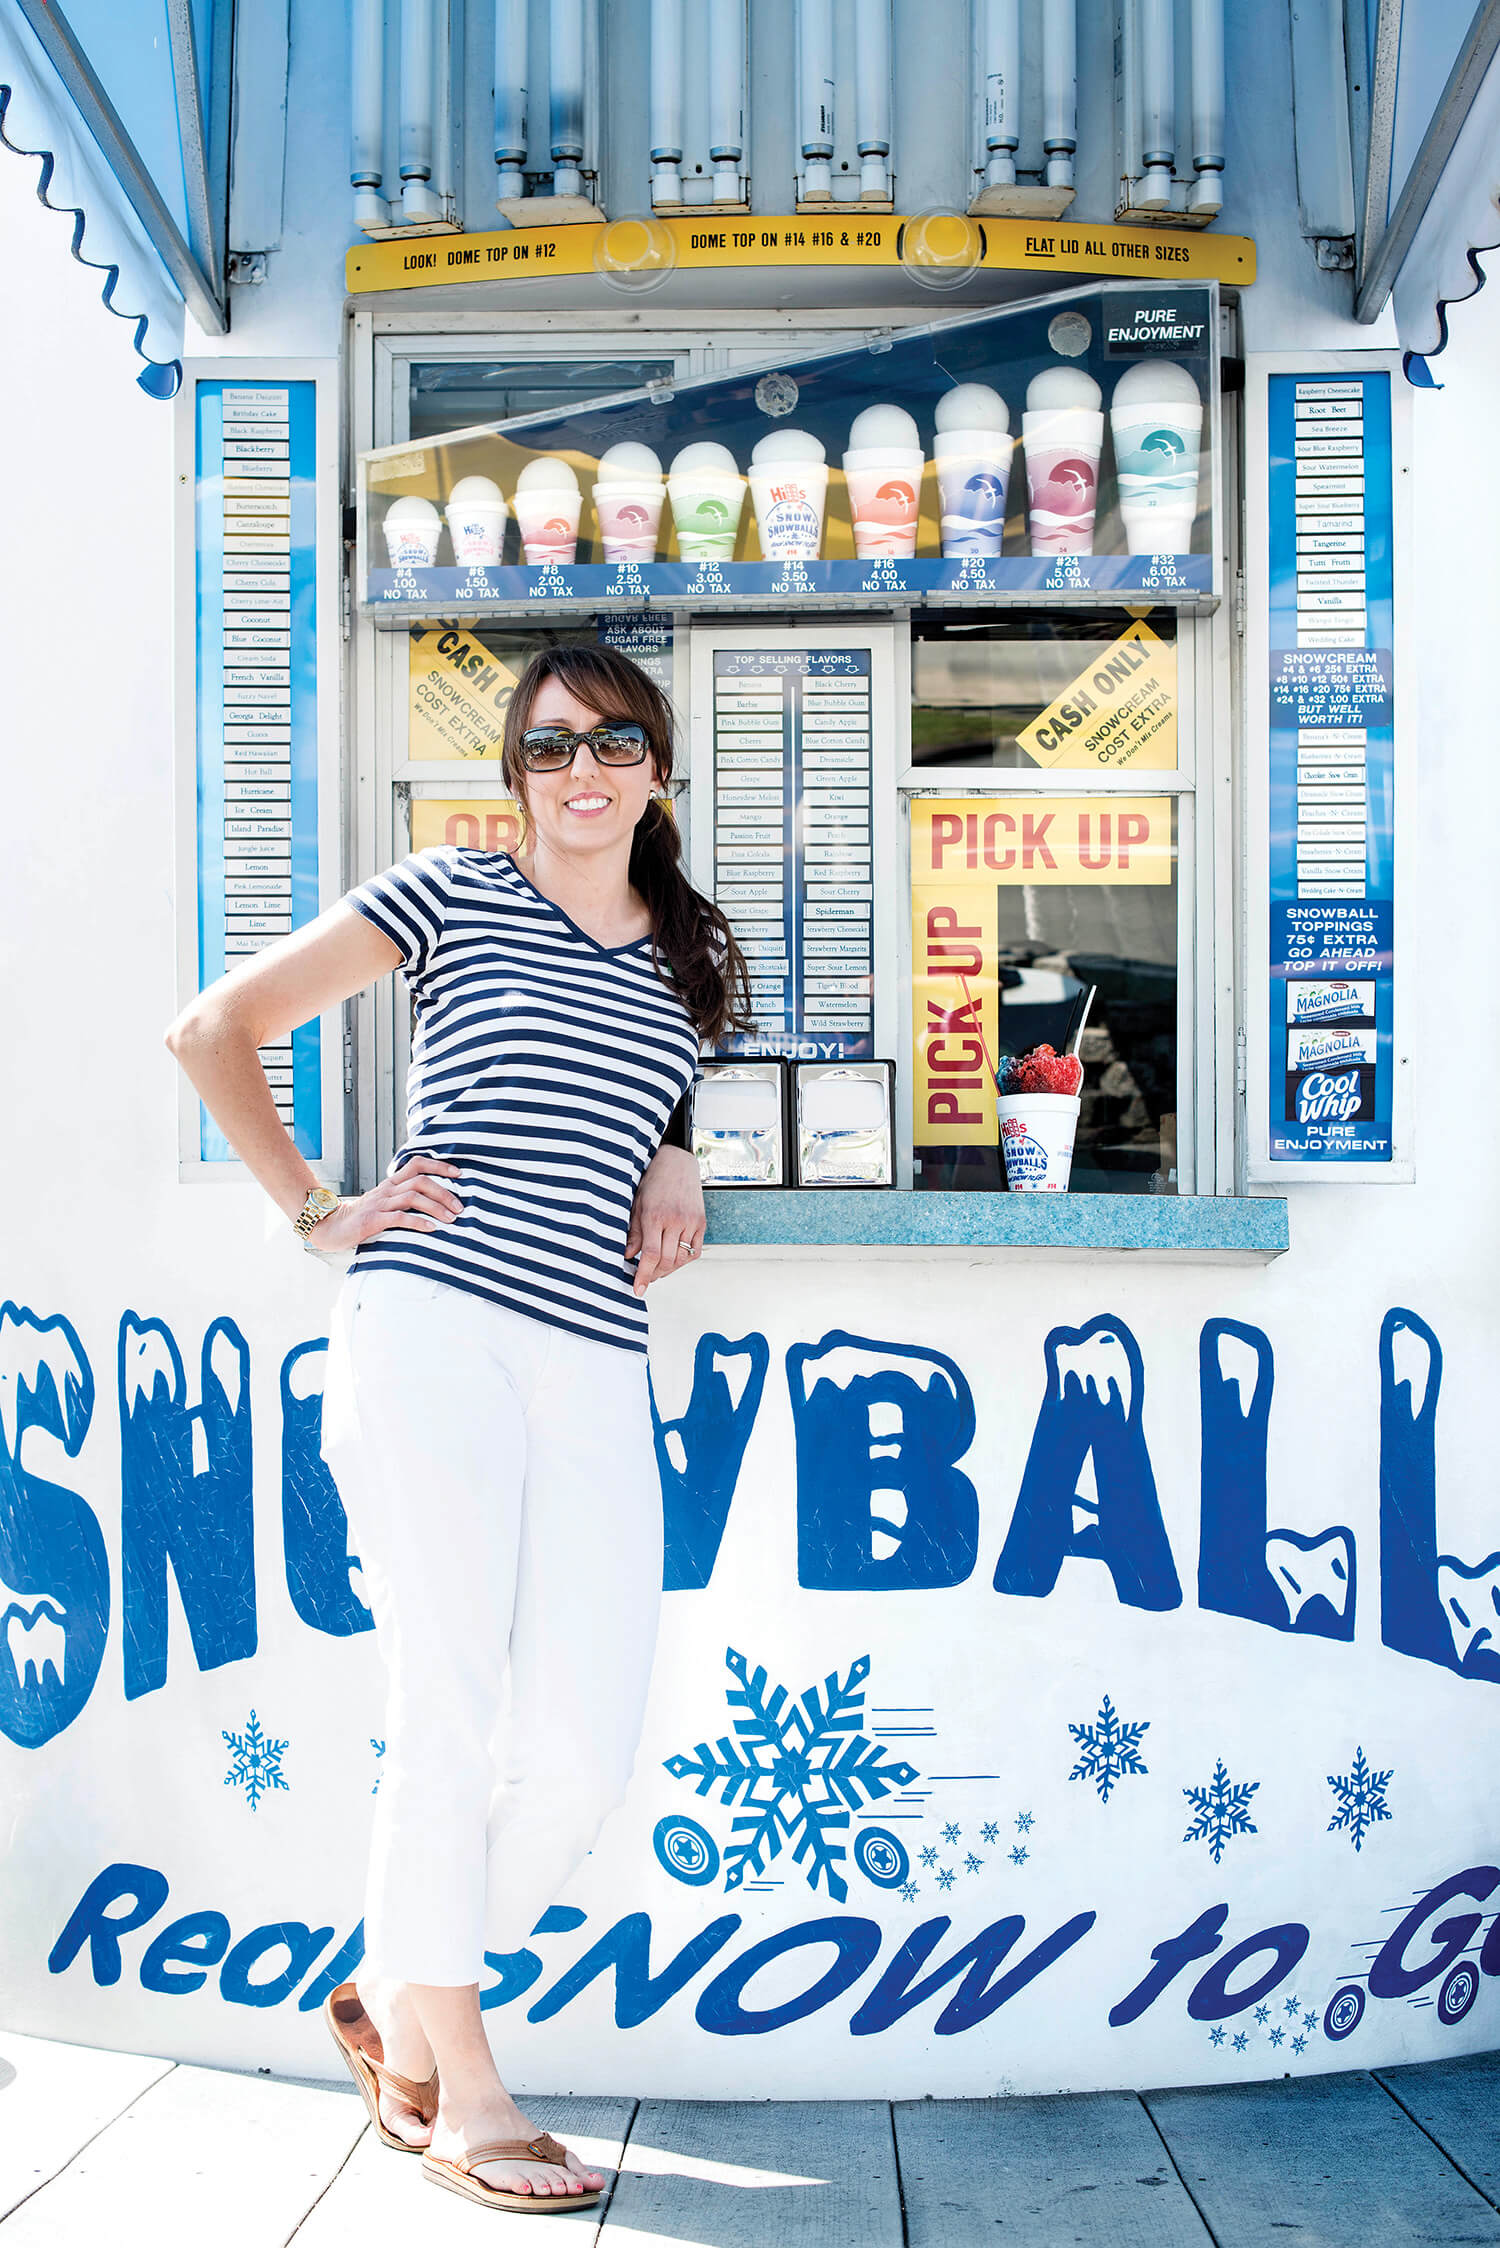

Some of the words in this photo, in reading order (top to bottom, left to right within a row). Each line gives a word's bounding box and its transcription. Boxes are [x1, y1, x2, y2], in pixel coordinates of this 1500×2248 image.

[691, 234, 726, 249] DOME
[732, 233, 756, 247] TOP
[761, 232, 778, 246] ON
[784, 232, 806, 246] #14
[812, 232, 834, 247] #16
[841, 232, 849, 246] &
[857, 232, 881, 247] #20
[1026, 237, 1055, 253] FLAT
[1061, 239, 1079, 254] LID
[1085, 240, 1107, 256] ALL
[1111, 242, 1149, 259] OTHER
[1155, 246, 1190, 262] SIZES
[404, 253, 437, 270] LOOK!
[448, 250, 480, 266] DOME
[486, 247, 508, 262] TOP
[514, 245, 529, 259] ON
[535, 243, 556, 258] #12
[1134, 309, 1176, 323] PURE
[1108, 325, 1204, 341] ENJOYMENT
[776, 513, 813, 522] SNOW
[768, 523, 818, 538] SNOWBALLS
[1313, 540, 1346, 548] Tangerine
[873, 559, 894, 569] #16
[961, 558, 985, 568] #20
[1056, 556, 1079, 566] #24
[1152, 555, 1174, 565] #32
[543, 565, 558, 575] #8
[618, 564, 639, 573] #10
[699, 562, 719, 572] #12
[784, 561, 804, 570] #14
[397, 567, 412, 578] #4
[469, 566, 484, 576] #6
[871, 570, 897, 580] 4.00
[960, 569, 985, 579] 4.50
[1054, 567, 1080, 577] 5.00
[1150, 566, 1176, 576] 6.00
[538, 576, 564, 586] 2.00
[616, 574, 641, 584] 2.50
[696, 573, 722, 583] 3.00
[782, 572, 808, 582] 3.50
[1142, 577, 1160, 587] NO
[1164, 576, 1186, 586] TAX
[393, 578, 416, 588] 1.00
[465, 578, 488, 587] 1.50
[772, 583, 789, 592] NO
[794, 582, 816, 592] TAX
[862, 581, 880, 591] NO
[885, 581, 906, 590] TAX
[952, 580, 969, 590] NO
[974, 579, 996, 589] TAX
[1046, 578, 1063, 588] NO
[1069, 578, 1090, 588] TAX
[384, 589, 402, 599] NO
[407, 589, 427, 599] TAX
[456, 589, 473, 598] NO
[479, 588, 499, 597] TAX
[529, 587, 547, 597] NO
[552, 586, 573, 596] TAX
[606, 585, 623, 595] NO
[628, 585, 650, 595] TAX
[687, 584, 704, 594] NO
[710, 584, 731, 593] TAX
[437, 632, 499, 693] CASH
[1284, 654, 1377, 664] SNOWCREAM
[1283, 665, 1294, 673] #4
[1298, 665, 1305, 673] &
[1310, 665, 1320, 673] #6
[1346, 665, 1377, 673] EXTRA
[231, 673, 254, 681] French
[260, 673, 284, 681] Vanilla
[1312, 675, 1326, 683] #12
[1352, 675, 1384, 683] EXTRA
[1036, 689, 1098, 750] CASH
[1093, 634, 1151, 695] ONLY
[1274, 685, 1289, 693] #14
[1294, 685, 1309, 693] #16
[1313, 685, 1330, 693] #20
[1309, 695, 1325, 703] #32
[1330, 695, 1348, 703] 1.00
[1352, 695, 1384, 703] EXTRA
[428, 671, 501, 743] SNOWCREAM
[1298, 705, 1323, 713] BUT
[1328, 705, 1361, 713] WELL
[1085, 678, 1159, 751] SNOWCREAM
[1299, 715, 1342, 723] WORTH
[1346, 715, 1362, 723] IT!
[417, 684, 449, 715] COST
[448, 716, 486, 756] EXTRA
[1098, 729, 1130, 763] COST
[1131, 692, 1172, 731] EXTRA
[1117, 756, 1126, 765] We
[1126, 741, 1142, 758] Don't
[1141, 732, 1152, 743] Mix
[1152, 712, 1173, 732] Creams
[931, 814, 1058, 869] PICK
[1078, 814, 1150, 869] UP
[1287, 908, 1378, 918] SNOWBALL
[249, 920, 266, 928] Lime
[1292, 922, 1373, 931] TOPPINGS
[928, 906, 983, 977] UP
[1286, 935, 1315, 944] 75¢
[1324, 935, 1378, 944] EXTRA
[1288, 948, 1312, 957] GO
[1320, 948, 1375, 957] AHEAD
[1283, 961, 1315, 971] TOP
[1322, 961, 1338, 971] IT
[1345, 961, 1382, 971] OFF!
[1297, 989, 1358, 1012] MAGNOLIA
[743, 1043, 844, 1059] ENJOY!
[1299, 1036, 1359, 1060] MAGNOLIA
[928, 997, 983, 1124] PICK
[1302, 1071, 1359, 1100] Cool
[1300, 1091, 1361, 1124] Whip
[1307, 1126, 1355, 1136] PURE
[1275, 1140, 1387, 1150] ENJOYMENT
[1006, 1147, 1035, 1157] SNOW
[49, 1864, 365, 2011] Real
[1109, 1903, 1309, 2028] to
[1369, 1866, 1500, 1999] G
